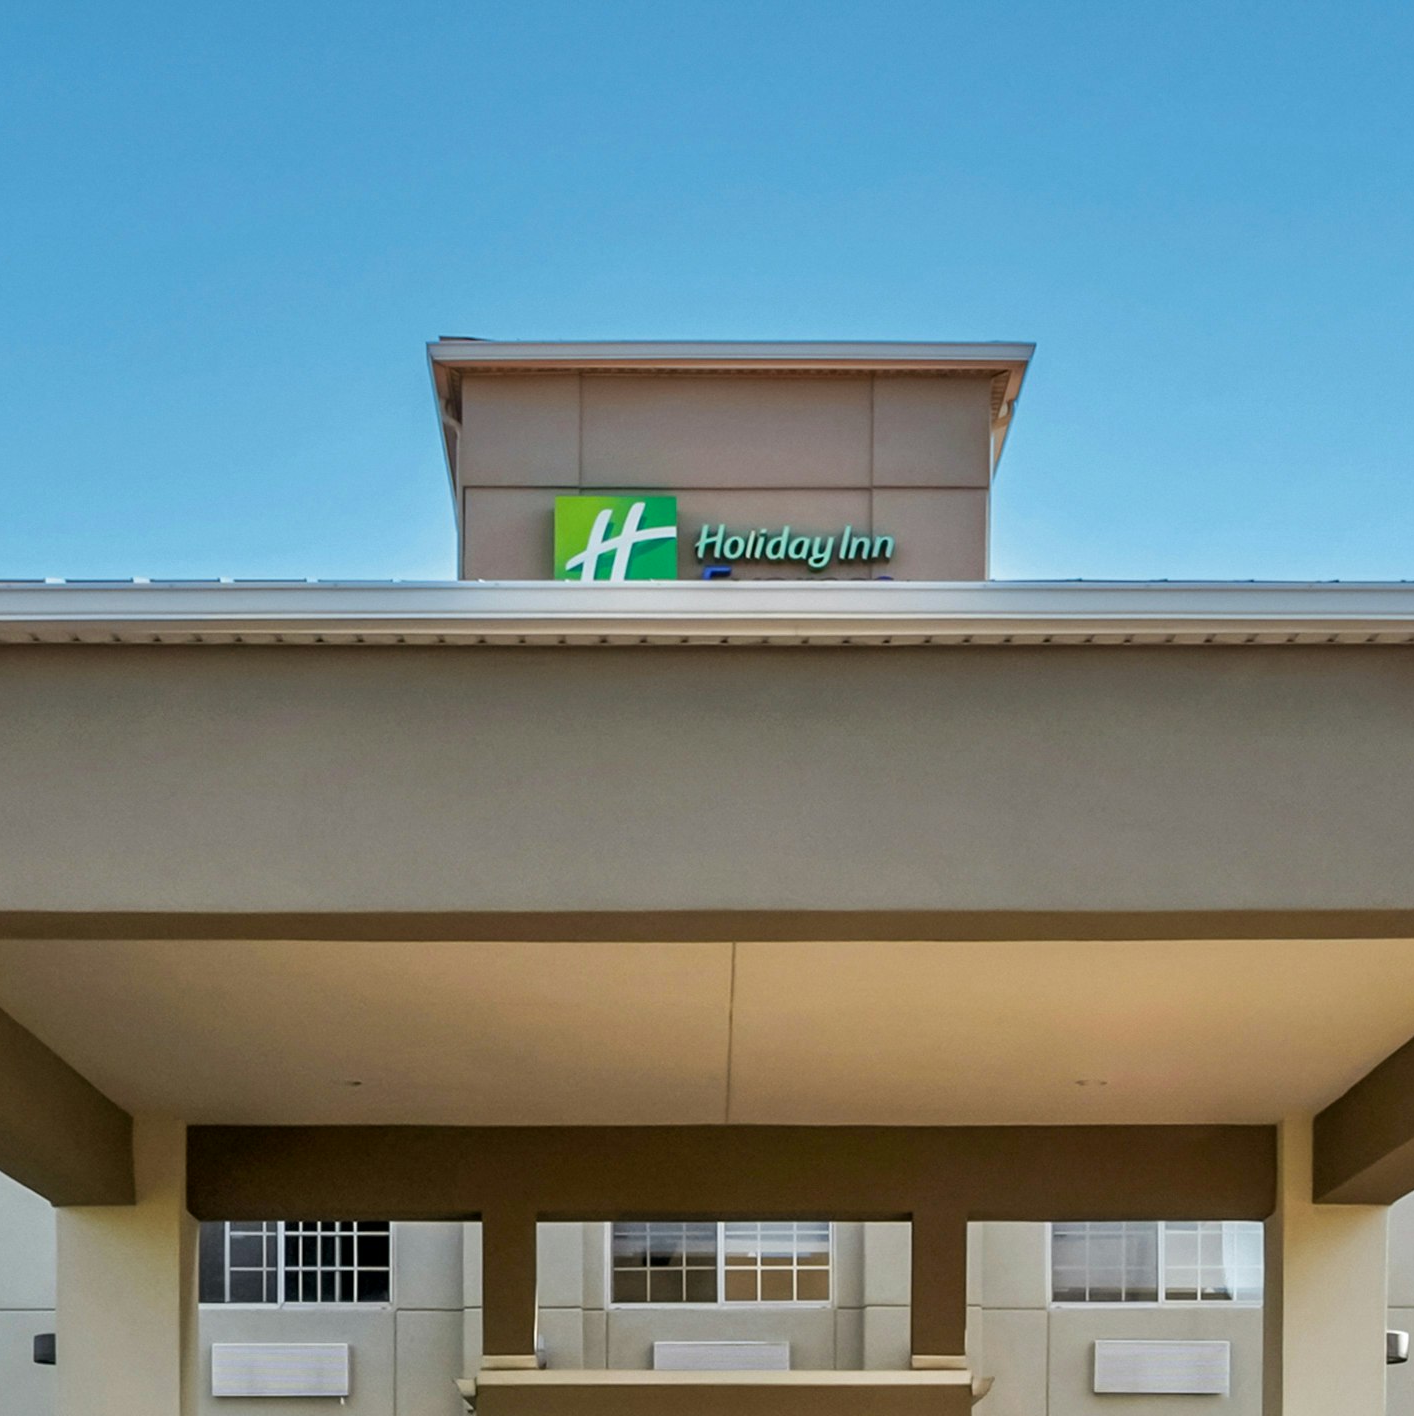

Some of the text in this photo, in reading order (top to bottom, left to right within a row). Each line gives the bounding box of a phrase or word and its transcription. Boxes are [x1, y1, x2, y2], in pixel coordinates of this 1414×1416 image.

[565, 501, 677, 581] H
[695, 524, 894, 569] Holiday Inn
